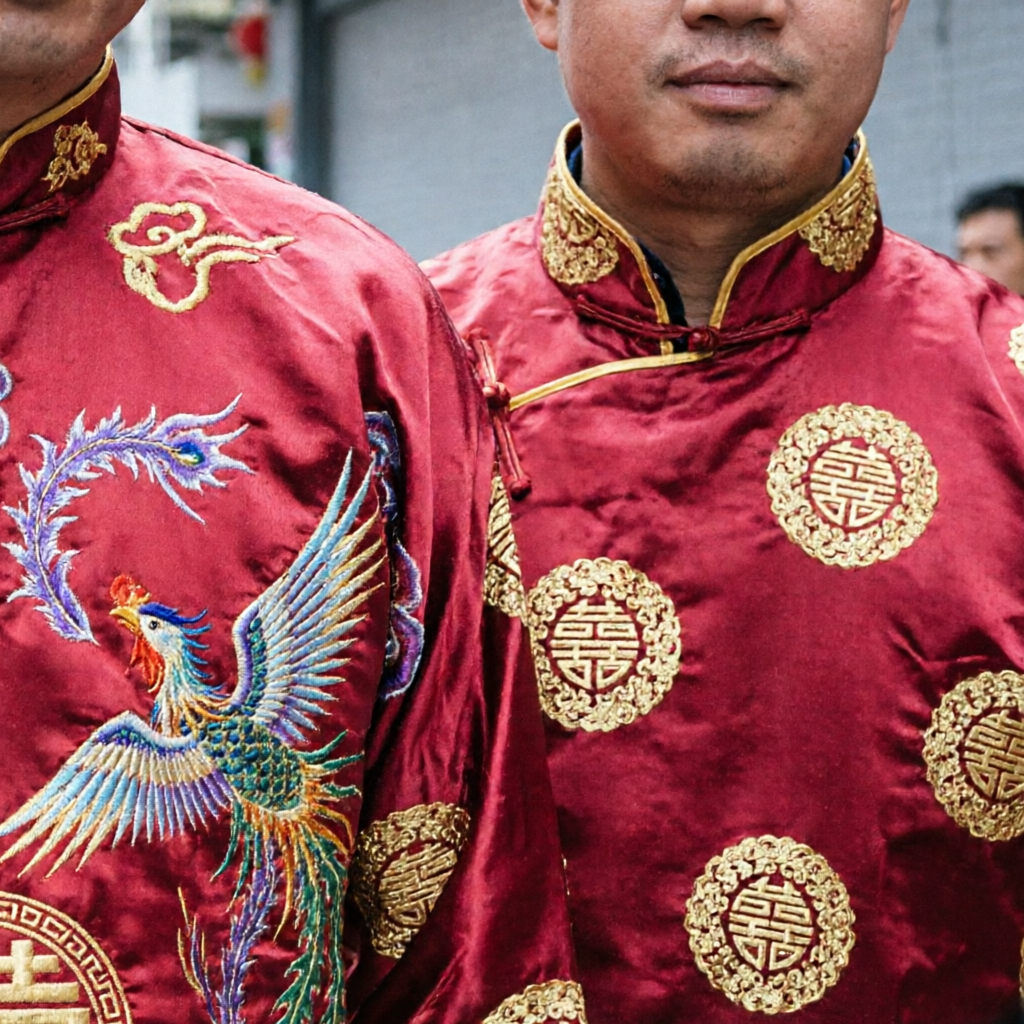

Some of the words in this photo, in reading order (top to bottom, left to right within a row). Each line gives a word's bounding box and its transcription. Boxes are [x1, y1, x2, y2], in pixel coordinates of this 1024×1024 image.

[810, 441, 895, 526] 囍
[550, 598, 639, 690] 囍
[729, 876, 813, 971] 囍
